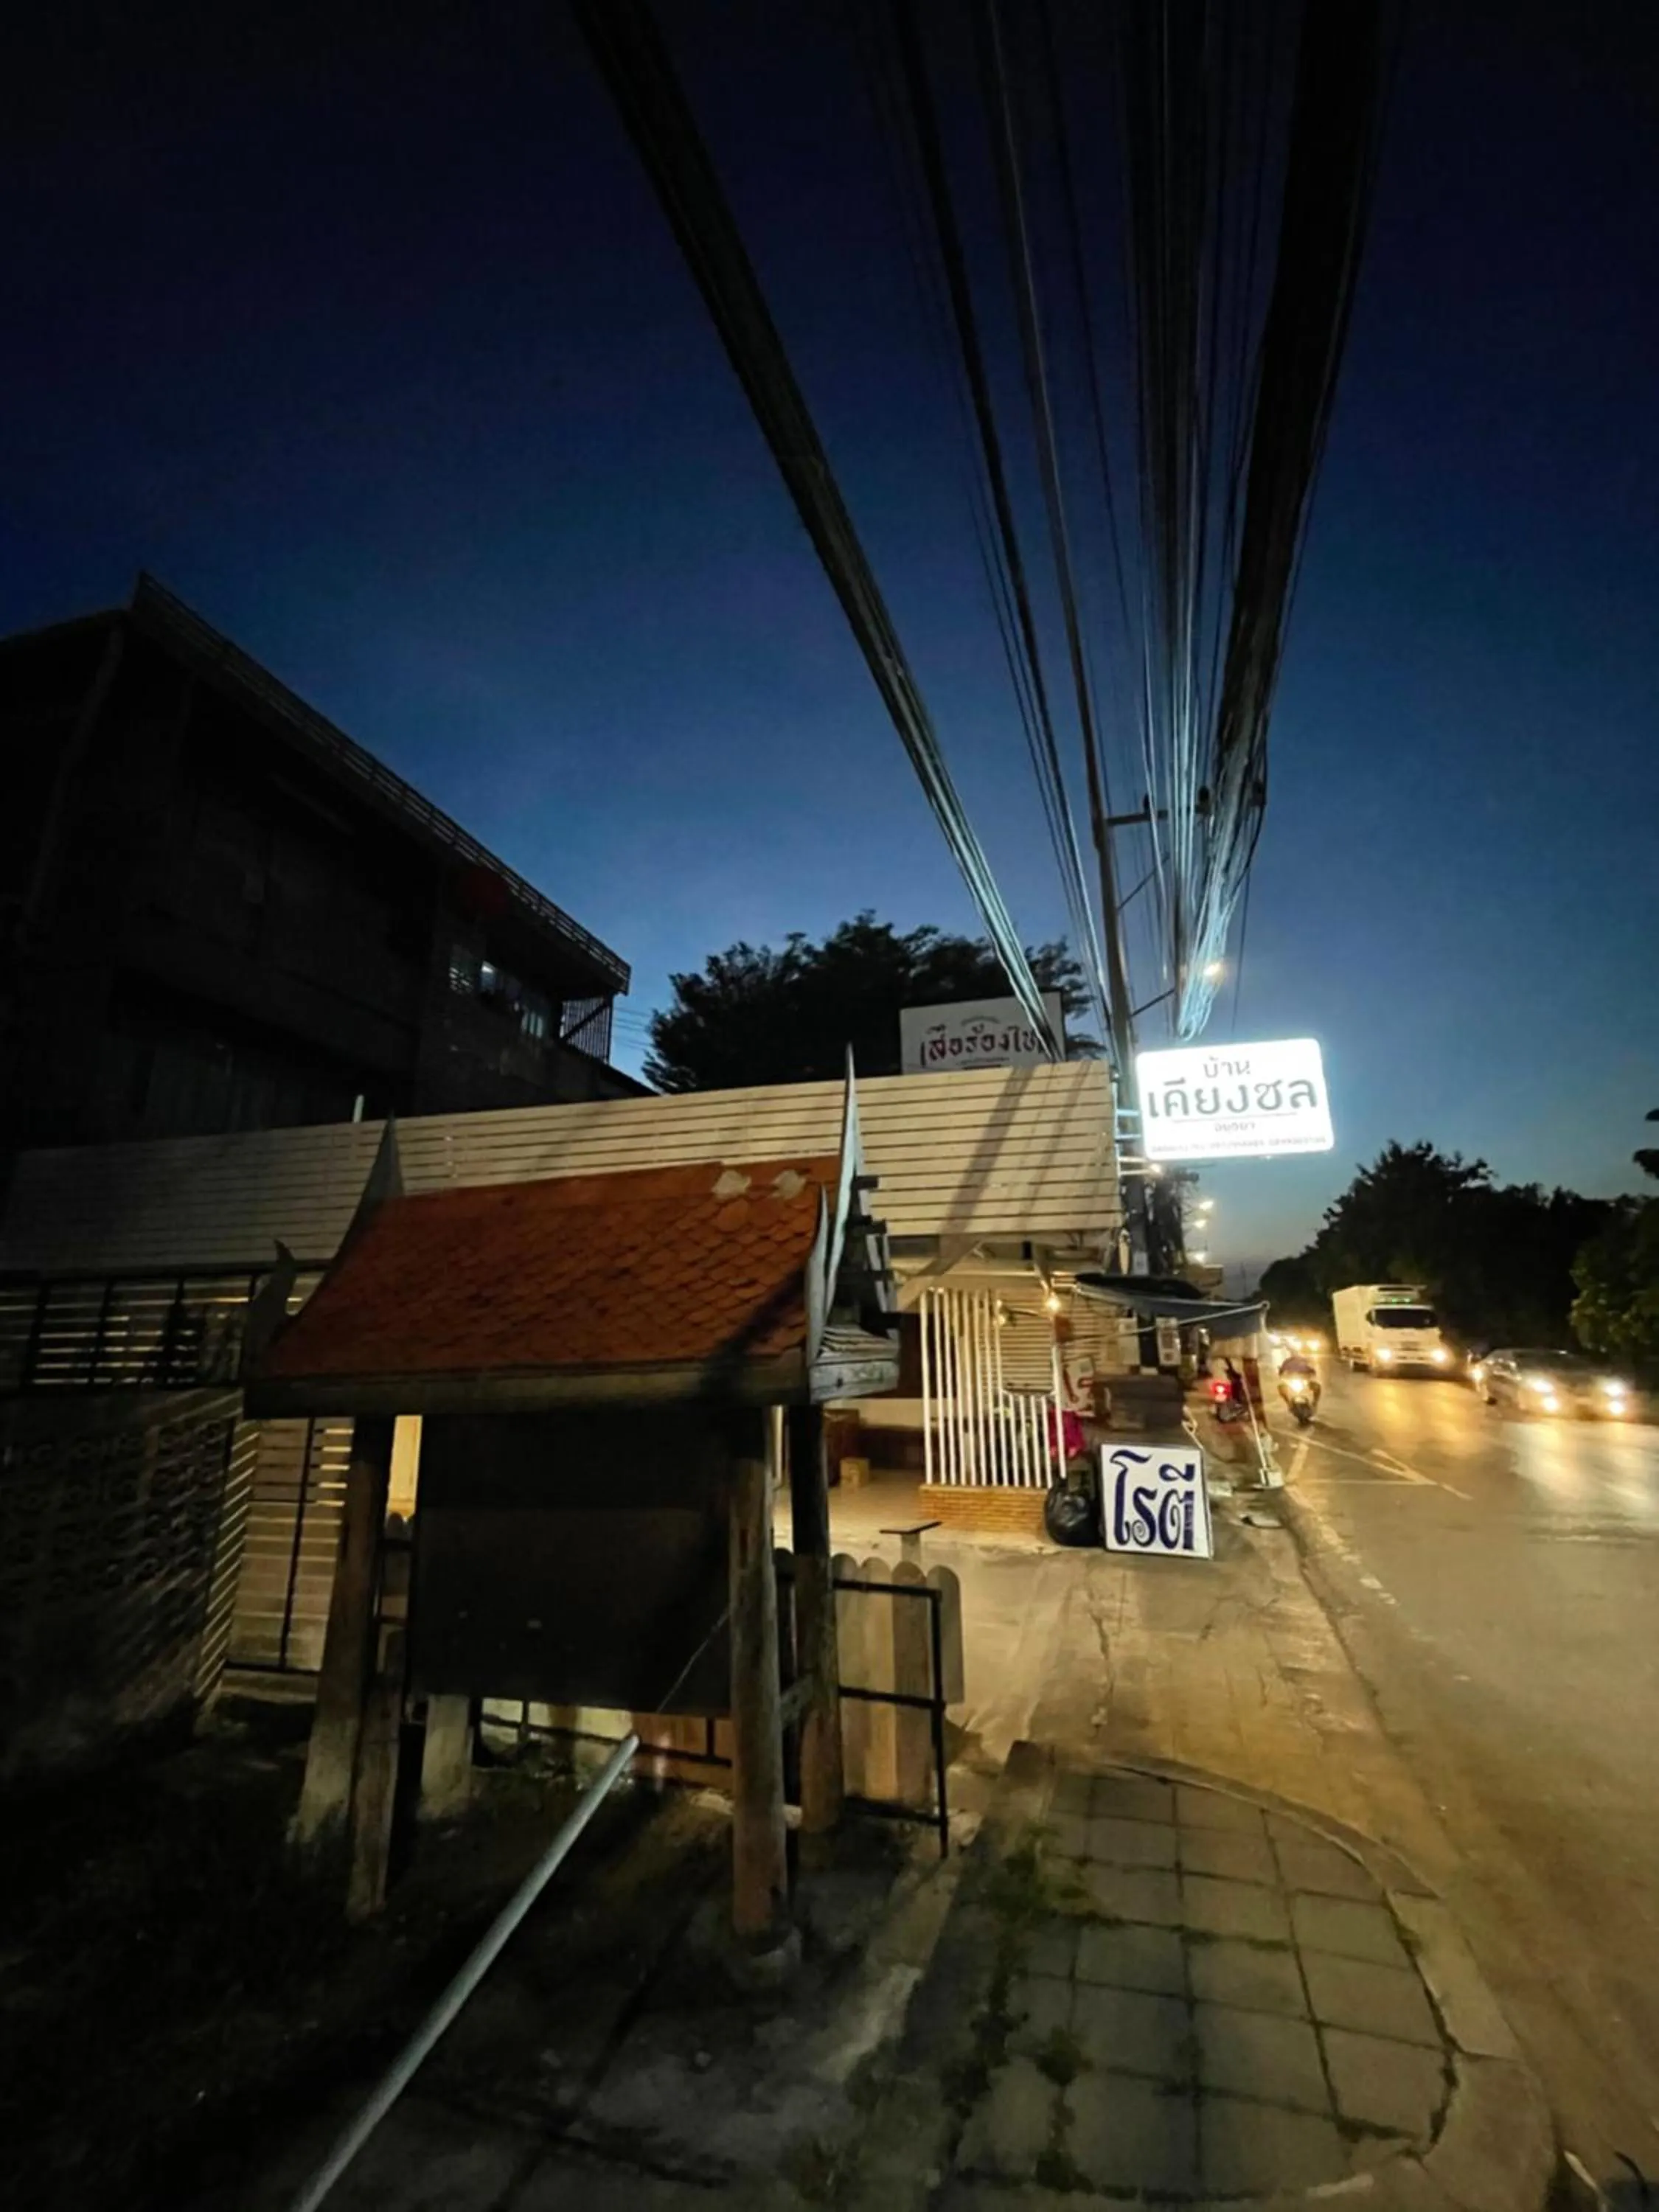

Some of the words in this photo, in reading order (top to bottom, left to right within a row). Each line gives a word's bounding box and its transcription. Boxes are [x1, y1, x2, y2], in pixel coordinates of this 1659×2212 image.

[1203, 1056, 1251, 1078] บ้าน
[1148, 1077, 1318, 1119] เคียงชล
[1110, 1450, 1195, 1550] โรตี
